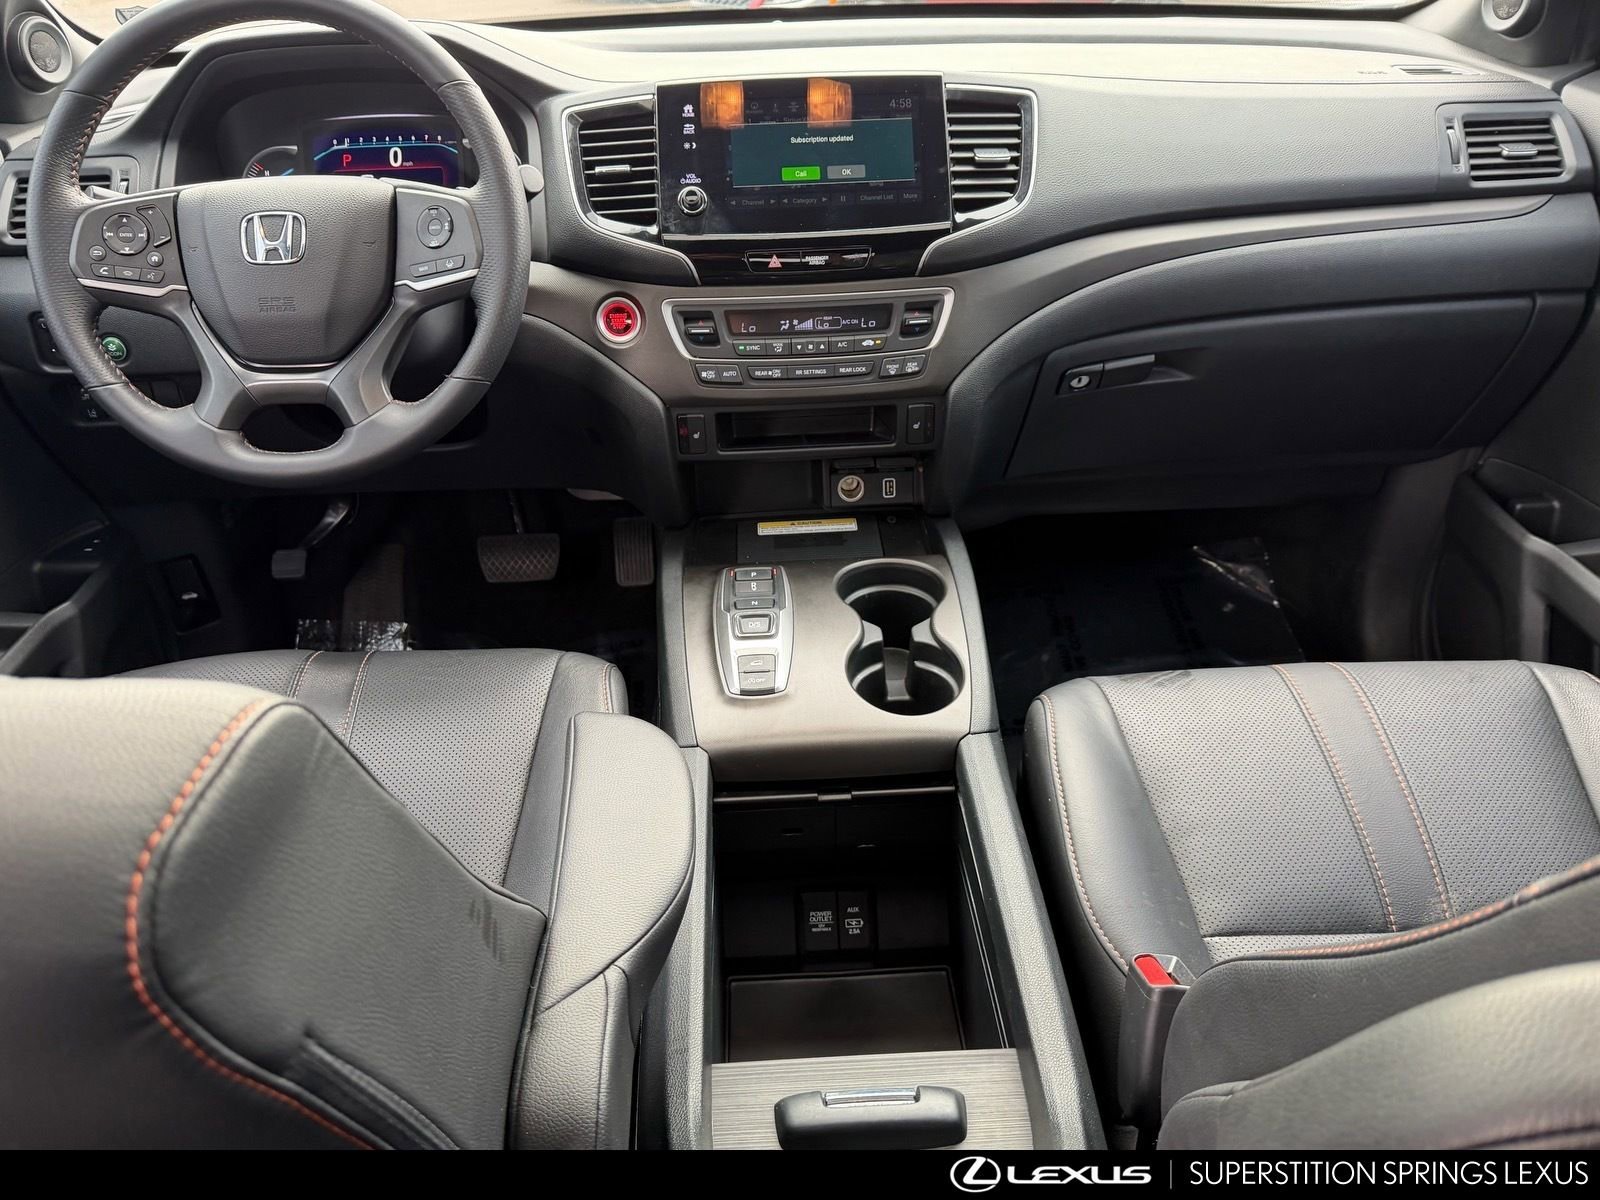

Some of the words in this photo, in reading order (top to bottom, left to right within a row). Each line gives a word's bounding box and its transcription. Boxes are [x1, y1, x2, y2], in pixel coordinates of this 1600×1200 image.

[889, 98, 912, 109] 4:58
[790, 136, 828, 144] Subscription
[829, 134, 854, 142] updated
[343, 154, 352, 167] P
[389, 147, 403, 168] 0
[841, 168, 852, 176] OK
